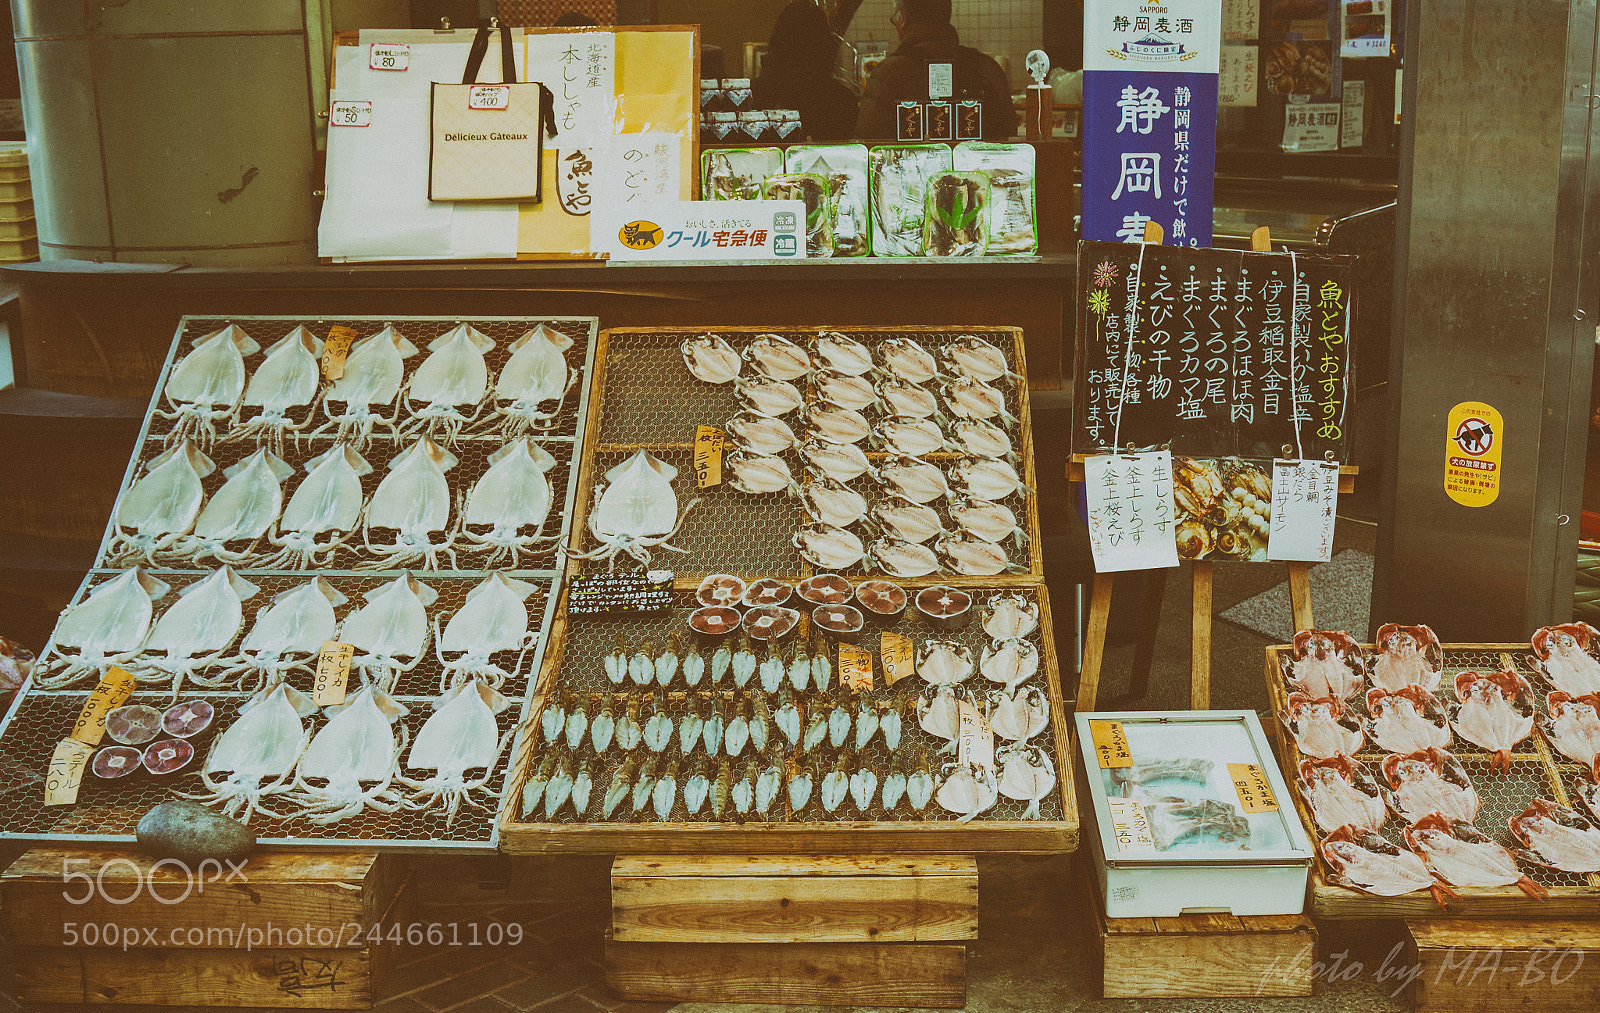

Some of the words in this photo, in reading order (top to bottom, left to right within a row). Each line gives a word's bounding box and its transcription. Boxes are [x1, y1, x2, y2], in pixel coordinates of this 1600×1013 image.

[1112, 15, 1194, 34] 静岡麦酒
[1139, 6, 1168, 14] SAPPORO
[558, 43, 583, 131] 本ししゃも
[585, 42, 603, 89] 北海道産
[444, 132, 488, 142] Délicieux
[489, 131, 529, 141] Gâteaux
[1171, 86, 1192, 247] 静岡県だけで飲
[666, 229, 768, 249] クール宅急便
[1103, 312, 1122, 427] 店内にて販売して
[1146, 273, 1175, 401] えびの干物
[1175, 274, 1208, 421] まぐろカマ塩
[1201, 275, 1229, 405] まぐろの尾
[1230, 276, 1255, 425] まぐろほほ肉
[1257, 278, 1288, 416] 伊豆稲取金目
[1316, 279, 1344, 440] 魚とやおすすめ
[1085, 368, 1106, 445] おります。
[1101, 468, 1125, 547] 釜上桜えび
[1123, 466, 1145, 547] 釜上しらす
[1151, 464, 1172, 536] 生しらす
[1305, 467, 1321, 504] 金目鯛
